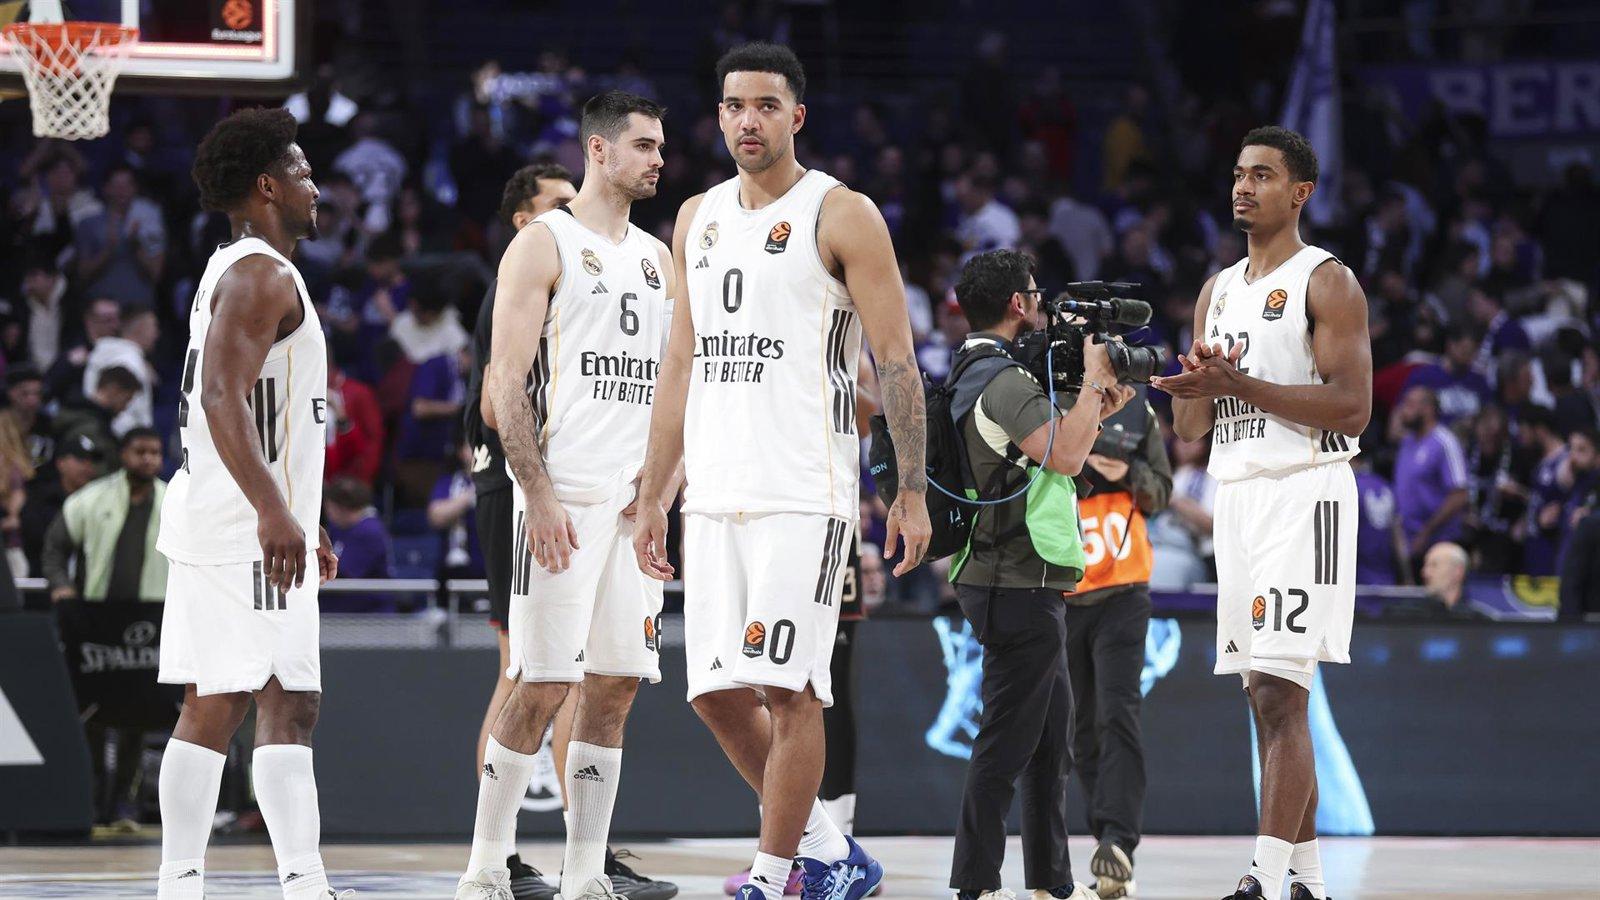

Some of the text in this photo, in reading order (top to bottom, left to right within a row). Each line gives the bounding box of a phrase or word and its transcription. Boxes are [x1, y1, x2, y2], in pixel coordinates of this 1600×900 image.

[723, 268, 743, 313] 0
[620, 292, 639, 336] 6
[580, 350, 660, 381] Emirate
[720, 361, 764, 383] BETTER
[593, 380, 654, 406] FLY BETTE
[1215, 418, 1266, 445] FLY BETTER
[1079, 511, 1132, 567] 50
[1269, 587, 1309, 634] 12
[80, 641, 160, 674] SPALD
[769, 619, 796, 665] 0
